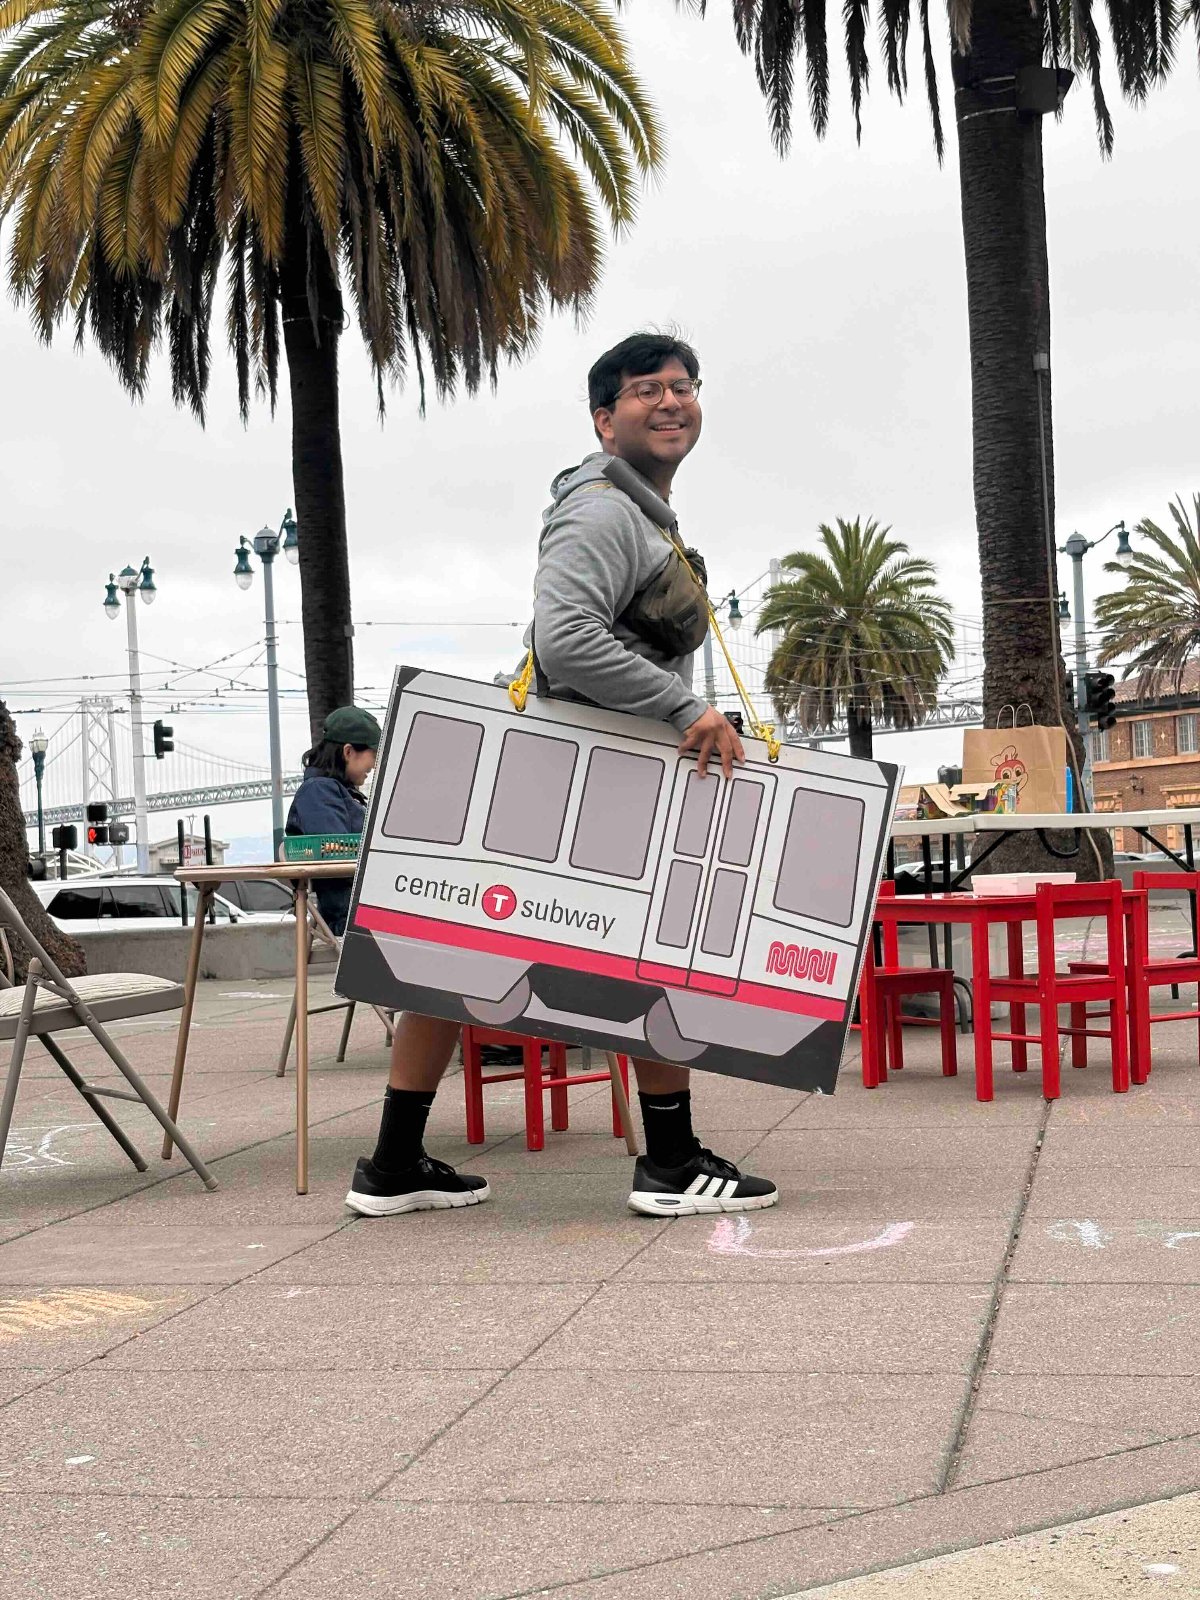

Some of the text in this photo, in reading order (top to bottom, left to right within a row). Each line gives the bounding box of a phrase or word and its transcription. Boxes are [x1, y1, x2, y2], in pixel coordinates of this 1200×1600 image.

[394, 874, 616, 939] central T subway
[765, 940, 839, 986] MUNI
